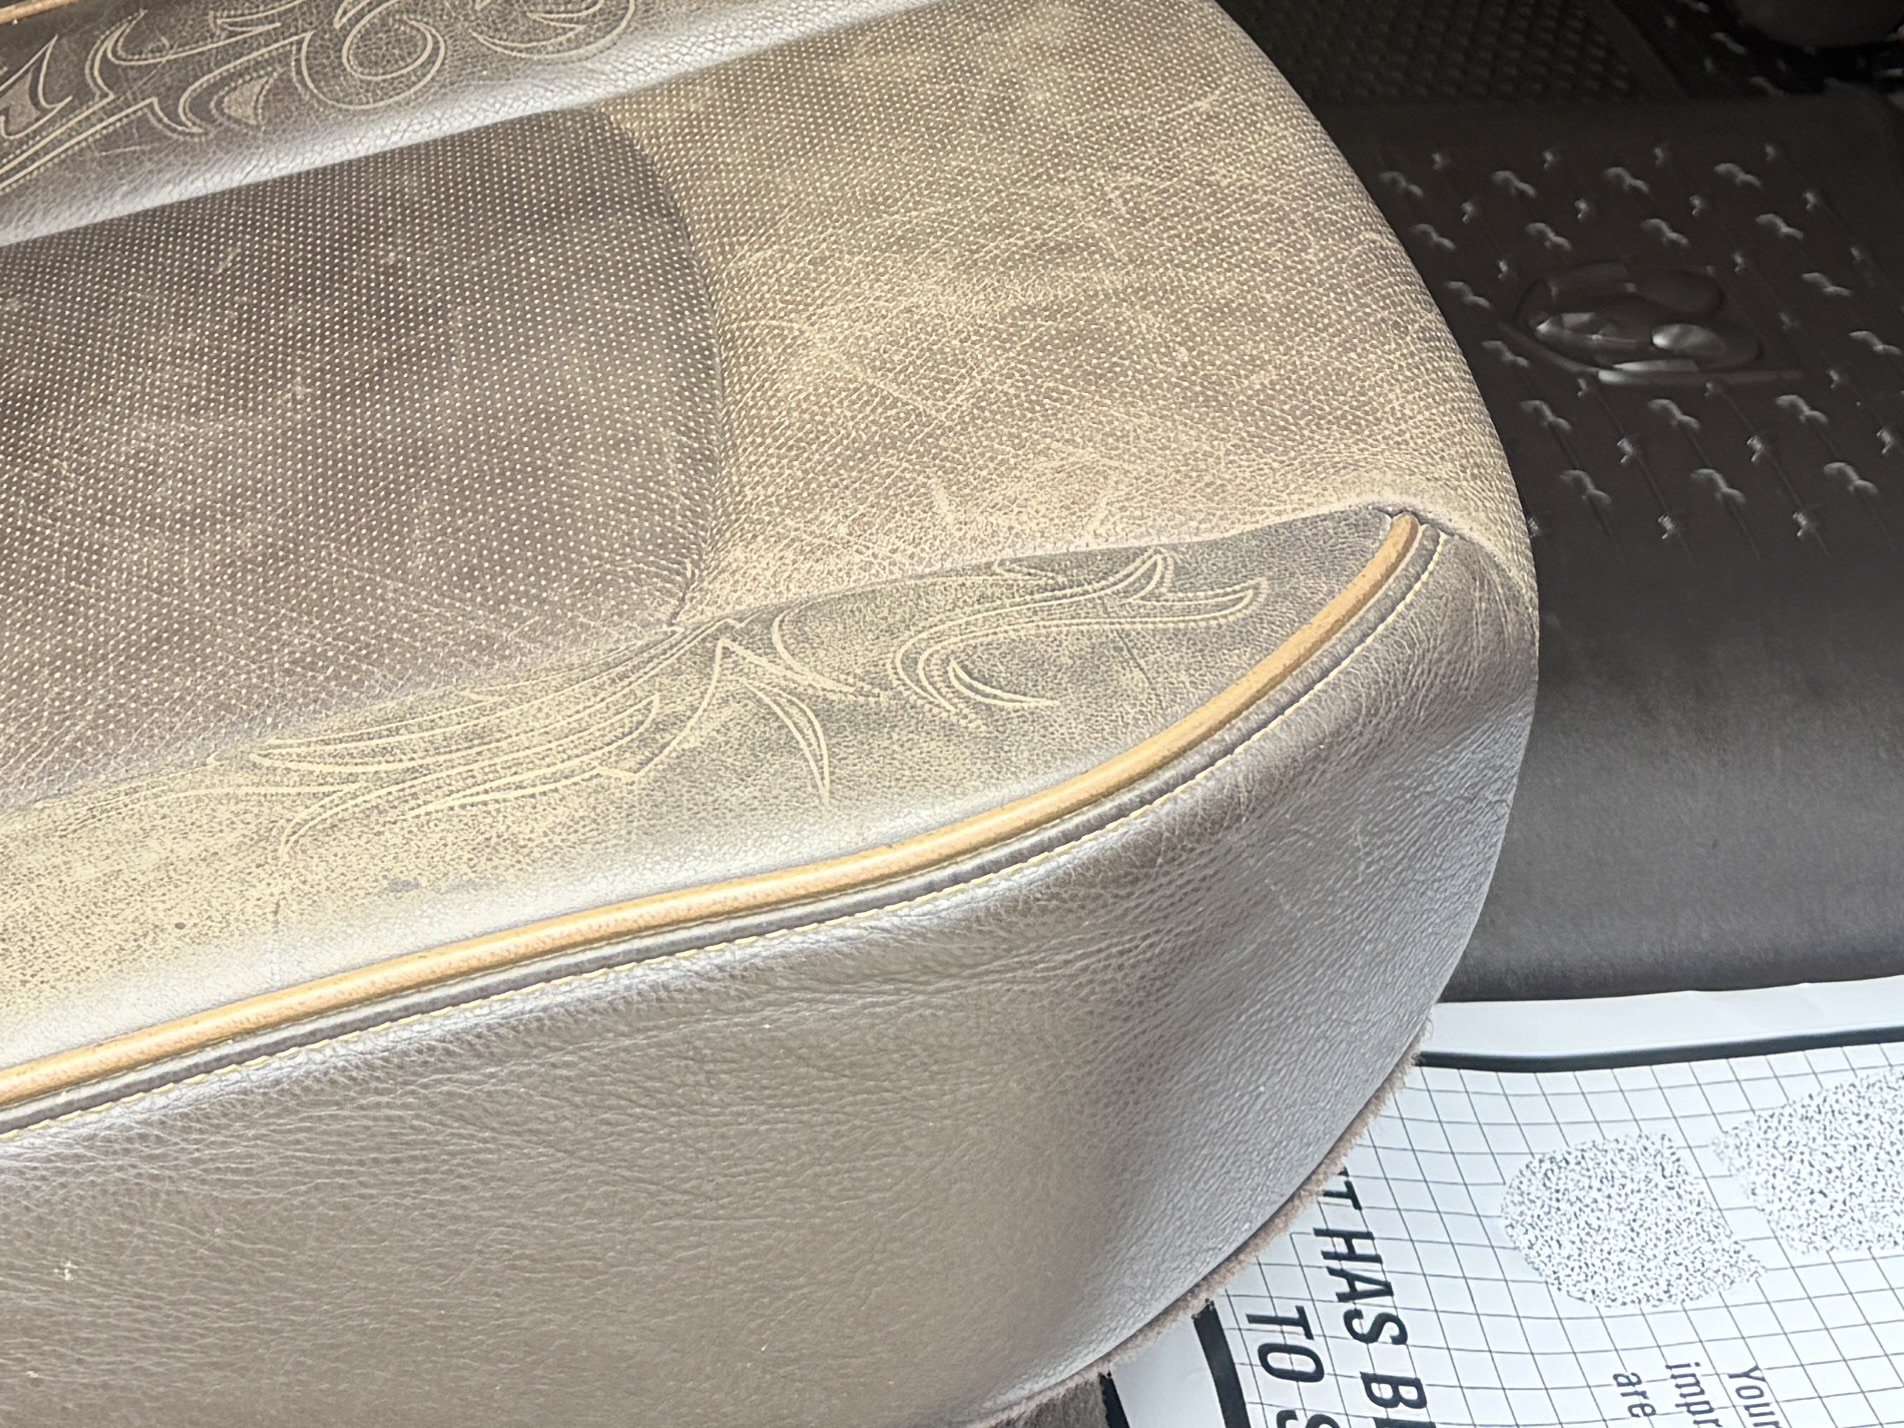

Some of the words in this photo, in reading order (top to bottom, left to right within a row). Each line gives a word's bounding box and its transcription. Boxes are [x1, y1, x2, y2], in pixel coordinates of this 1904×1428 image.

[1246, 1305, 1326, 1385] TO
[1313, 1227, 1409, 1346] HAS
[1361, 1371, 1437, 1428] B
[1612, 1372, 1657, 1418] are
